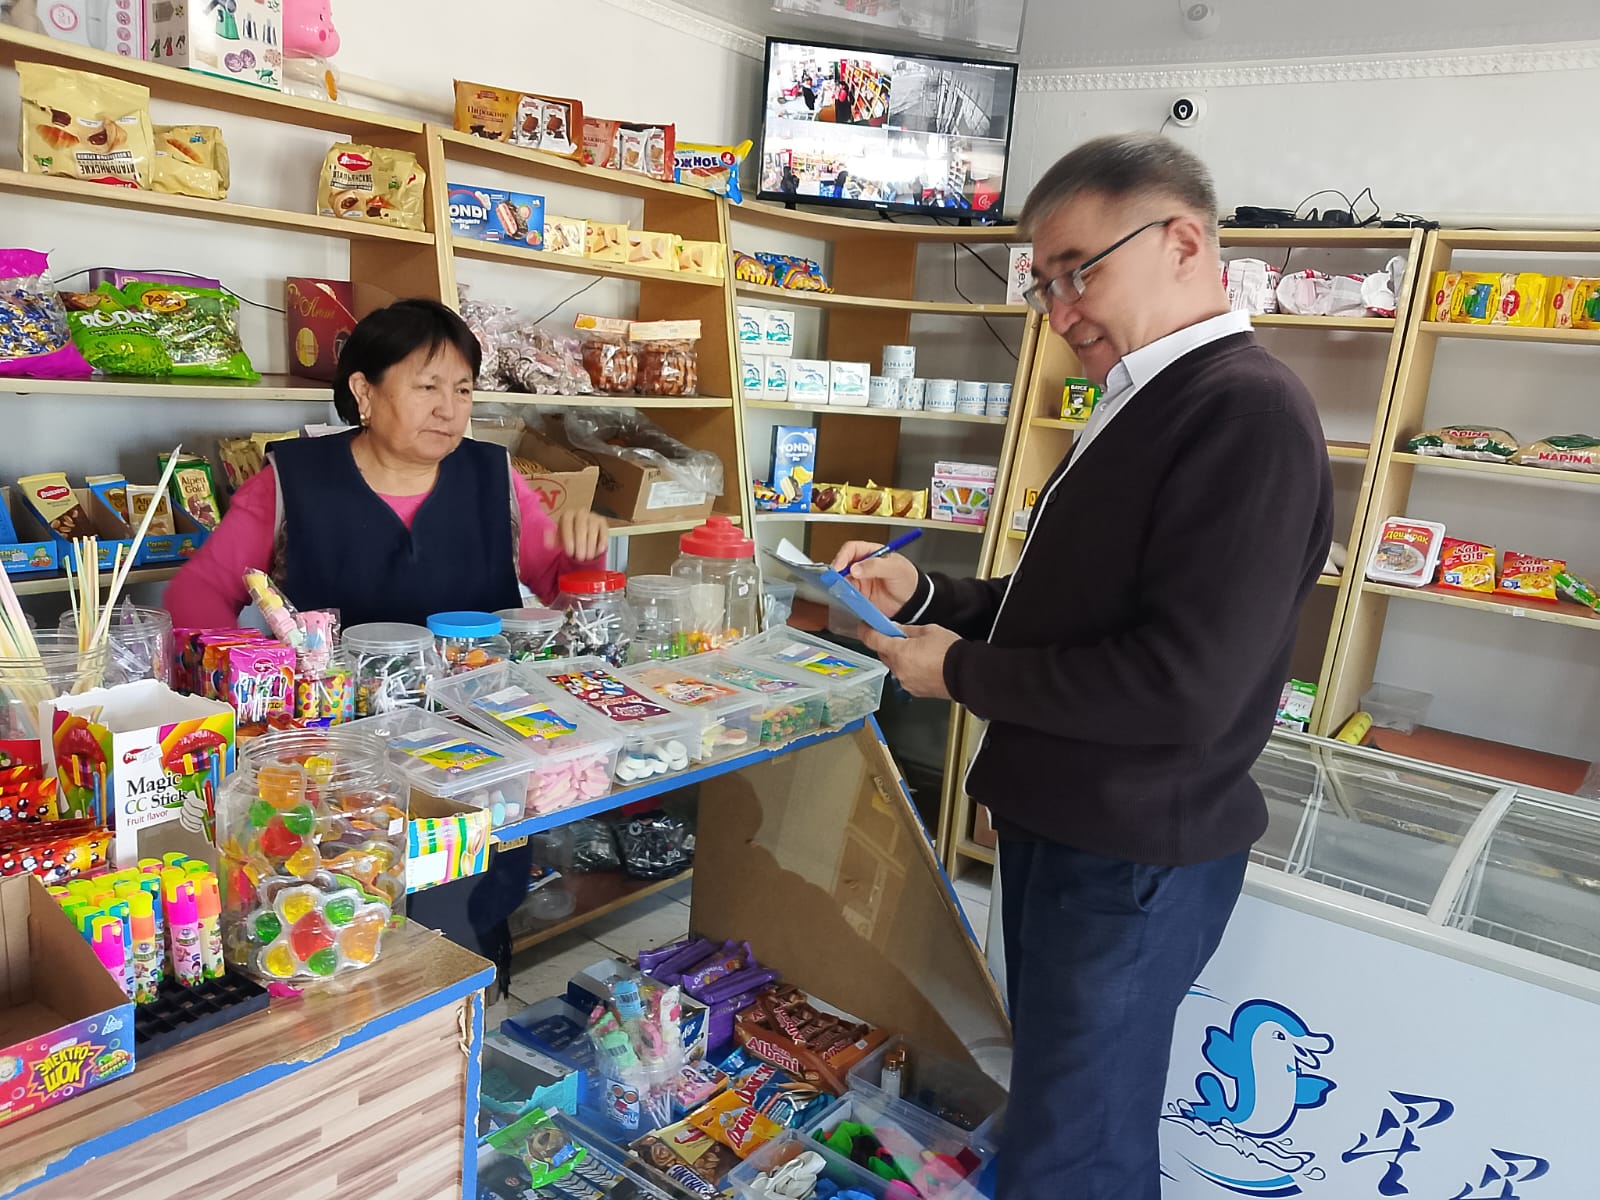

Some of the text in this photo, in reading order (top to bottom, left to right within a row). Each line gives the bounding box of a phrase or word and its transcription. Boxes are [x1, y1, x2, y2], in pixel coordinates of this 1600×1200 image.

[449, 203, 488, 221] ONDI
[181, 476, 207, 487] Alpen
[184, 485, 205, 494] Gold
[126, 770, 182, 797] Magic
[125, 790, 188, 815] CC Stick
[127, 810, 169, 826] Fruit flavor
[746, 1036, 800, 1075] Albeni
[43, 1060, 83, 1093] ШОК
